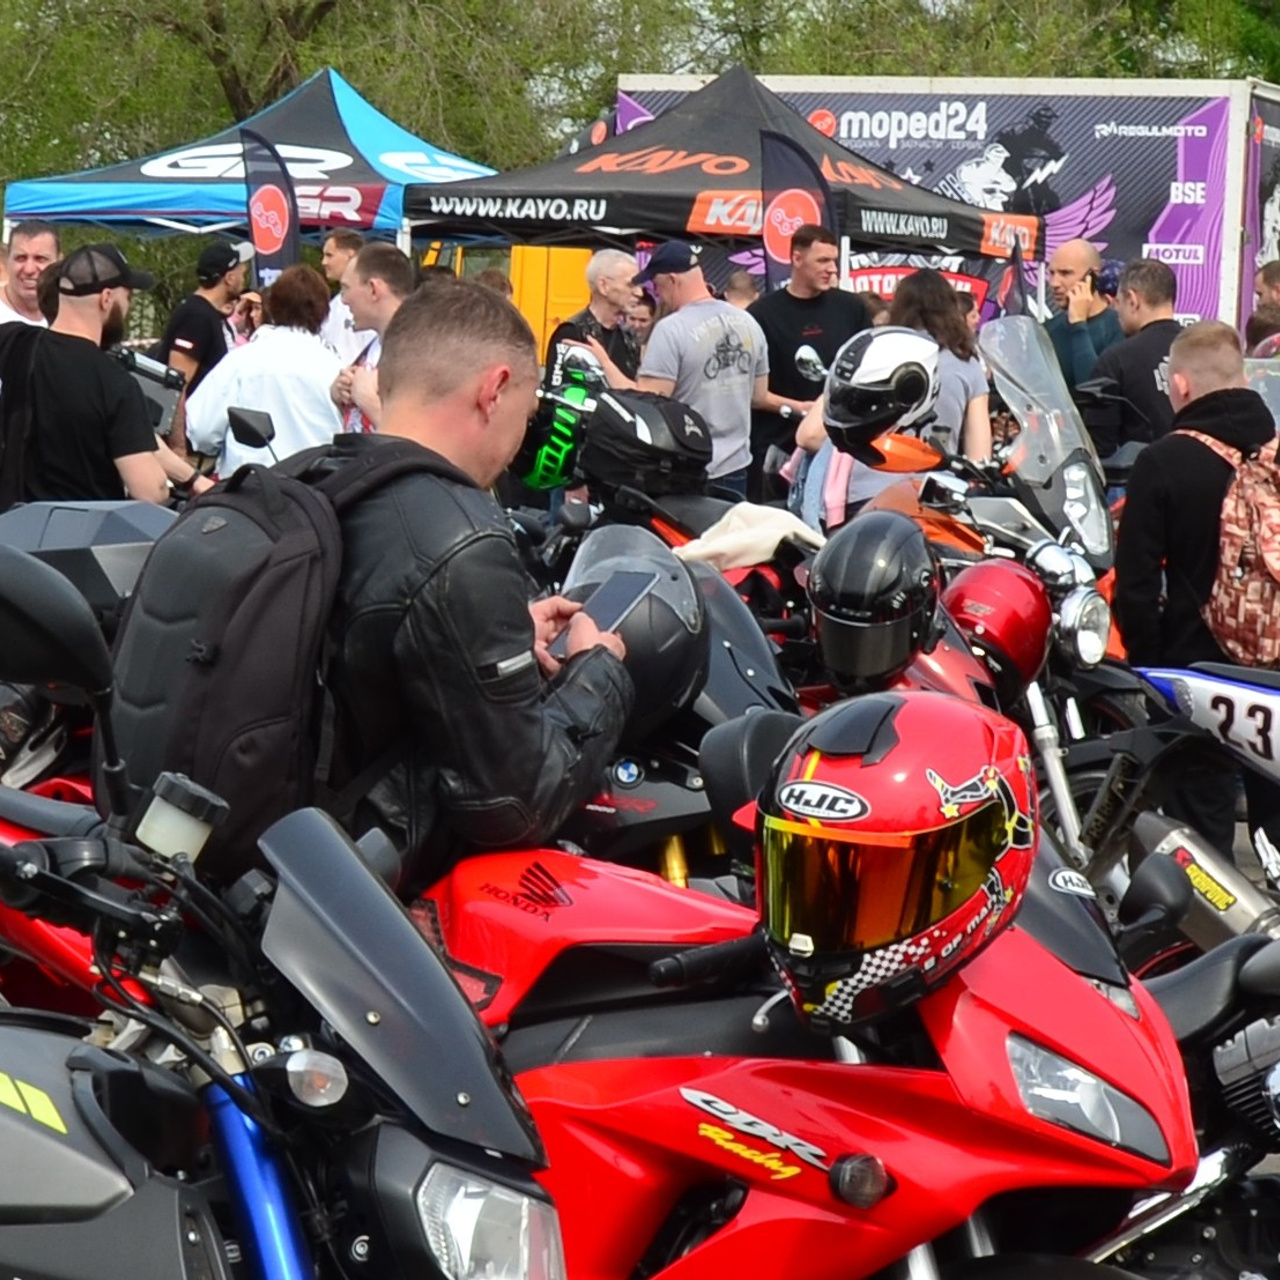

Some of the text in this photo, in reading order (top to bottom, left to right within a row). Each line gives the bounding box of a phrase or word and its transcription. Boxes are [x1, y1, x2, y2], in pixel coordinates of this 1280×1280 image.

[839, 101, 988, 149] moped24
[1118, 124, 1208, 138] REGULMOTO
[575, 144, 750, 175] KAYO
[430, 196, 607, 221] WWW.KAYO.RU
[1170, 182, 1206, 204] BSE
[860, 209, 949, 239] WWW.KAYO.RU
[1211, 696, 1275, 761] 23
[785, 788, 855, 814] HJC
[479, 883, 551, 923] HONDA
[678, 1086, 831, 1172] CBR
[698, 1123, 802, 1179] Racing
